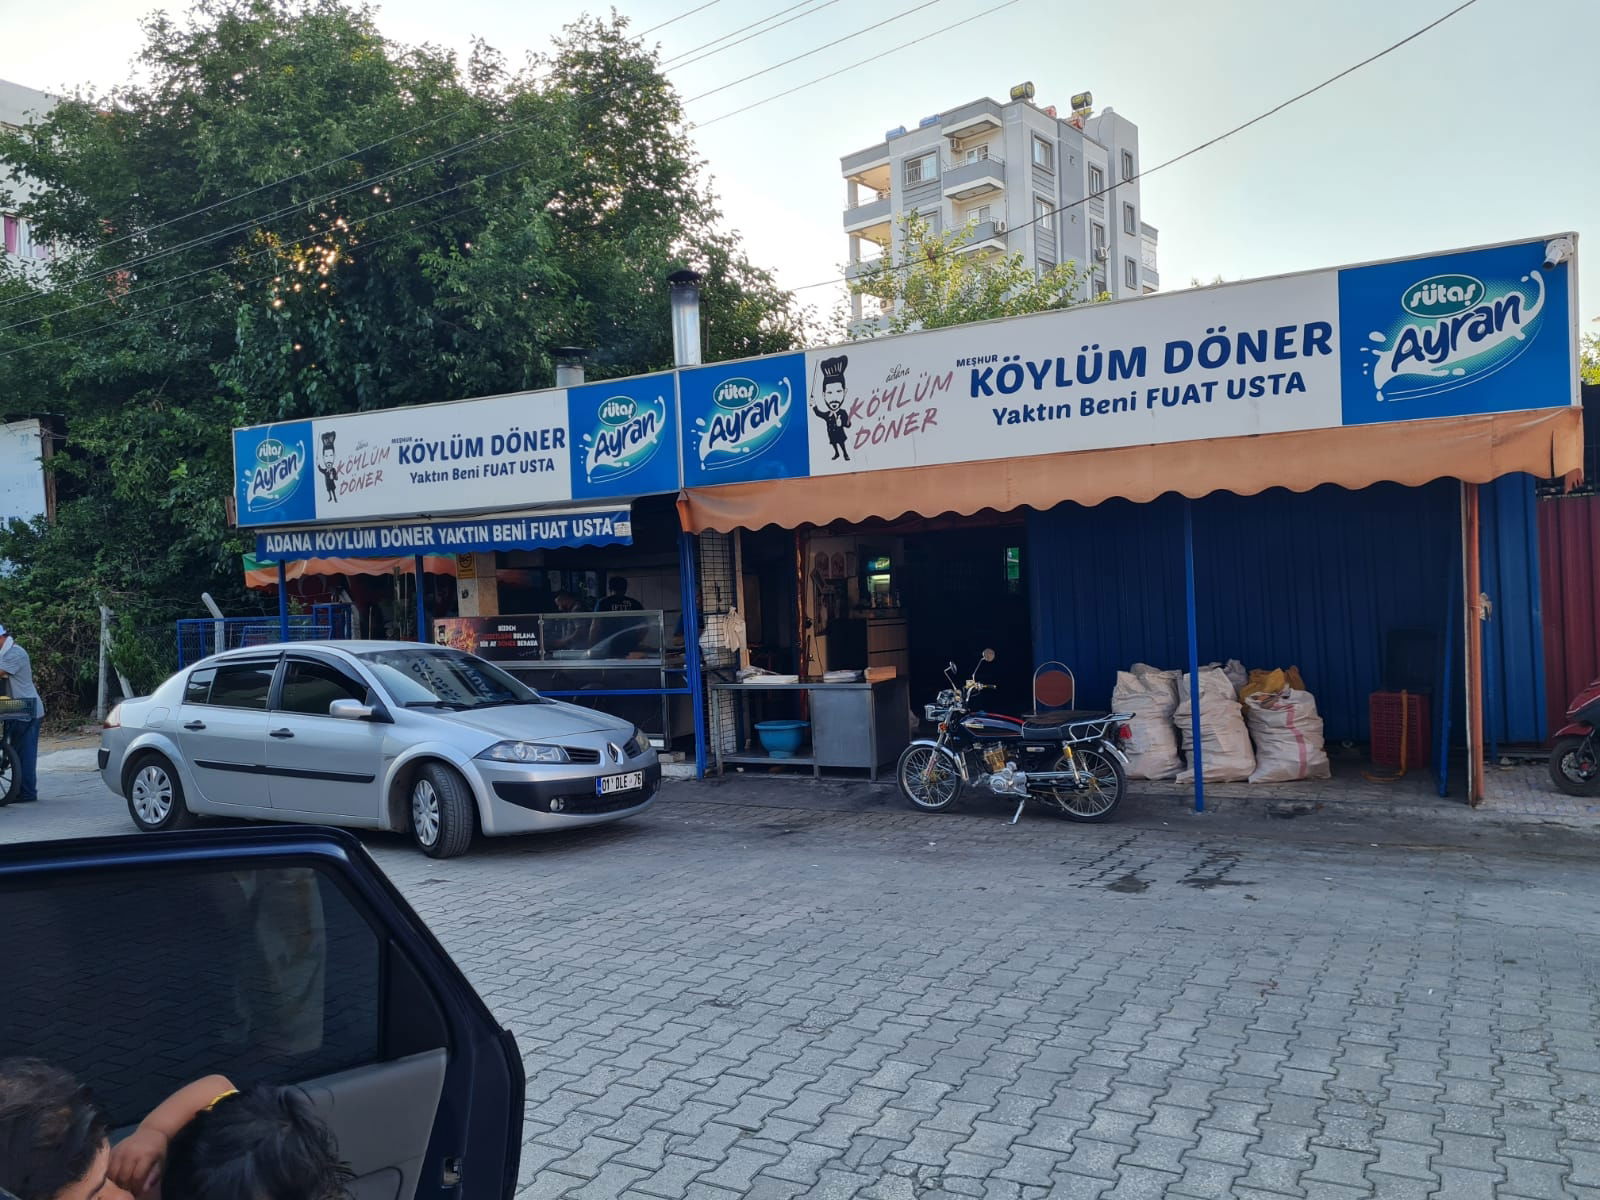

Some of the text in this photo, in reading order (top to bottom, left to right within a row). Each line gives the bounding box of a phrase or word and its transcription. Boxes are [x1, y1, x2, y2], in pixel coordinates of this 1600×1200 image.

[1410, 284, 1476, 307] sütaş
[1391, 295, 1521, 373] Ayran
[956, 353, 998, 368] MEŞHUR
[969, 321, 1334, 398] KÖYLÜM DÖNER
[717, 380, 755, 403] sütaş
[848, 371, 954, 420] KÖYLÜM
[992, 371, 1307, 427] Yaktın Beni FUAT USTA
[602, 402, 634, 419] sütaş
[709, 394, 779, 449] Ayran
[398, 427, 566, 465] KÖYLÜM DÖNER
[594, 412, 655, 464] Ayran
[853, 407, 938, 451] DÖNER
[258, 444, 283, 459] sütaş
[336, 445, 391, 476] KÖYLÜM
[253, 453, 298, 495] Ayran
[339, 470, 384, 496] DÖNER
[410, 458, 555, 484] Yaktın Beni FUAT USTA
[266, 533, 312, 553] ADANA
[315, 528, 377, 551] KÖYLÜM
[381, 525, 435, 548] DÖNER
[438, 525, 489, 545] YAKTIN
[493, 520, 527, 542] BENİ
[530, 520, 568, 540] FUAT
[572, 517, 613, 537] USTA
[602, 773, 642, 792] 01 DLE 76
